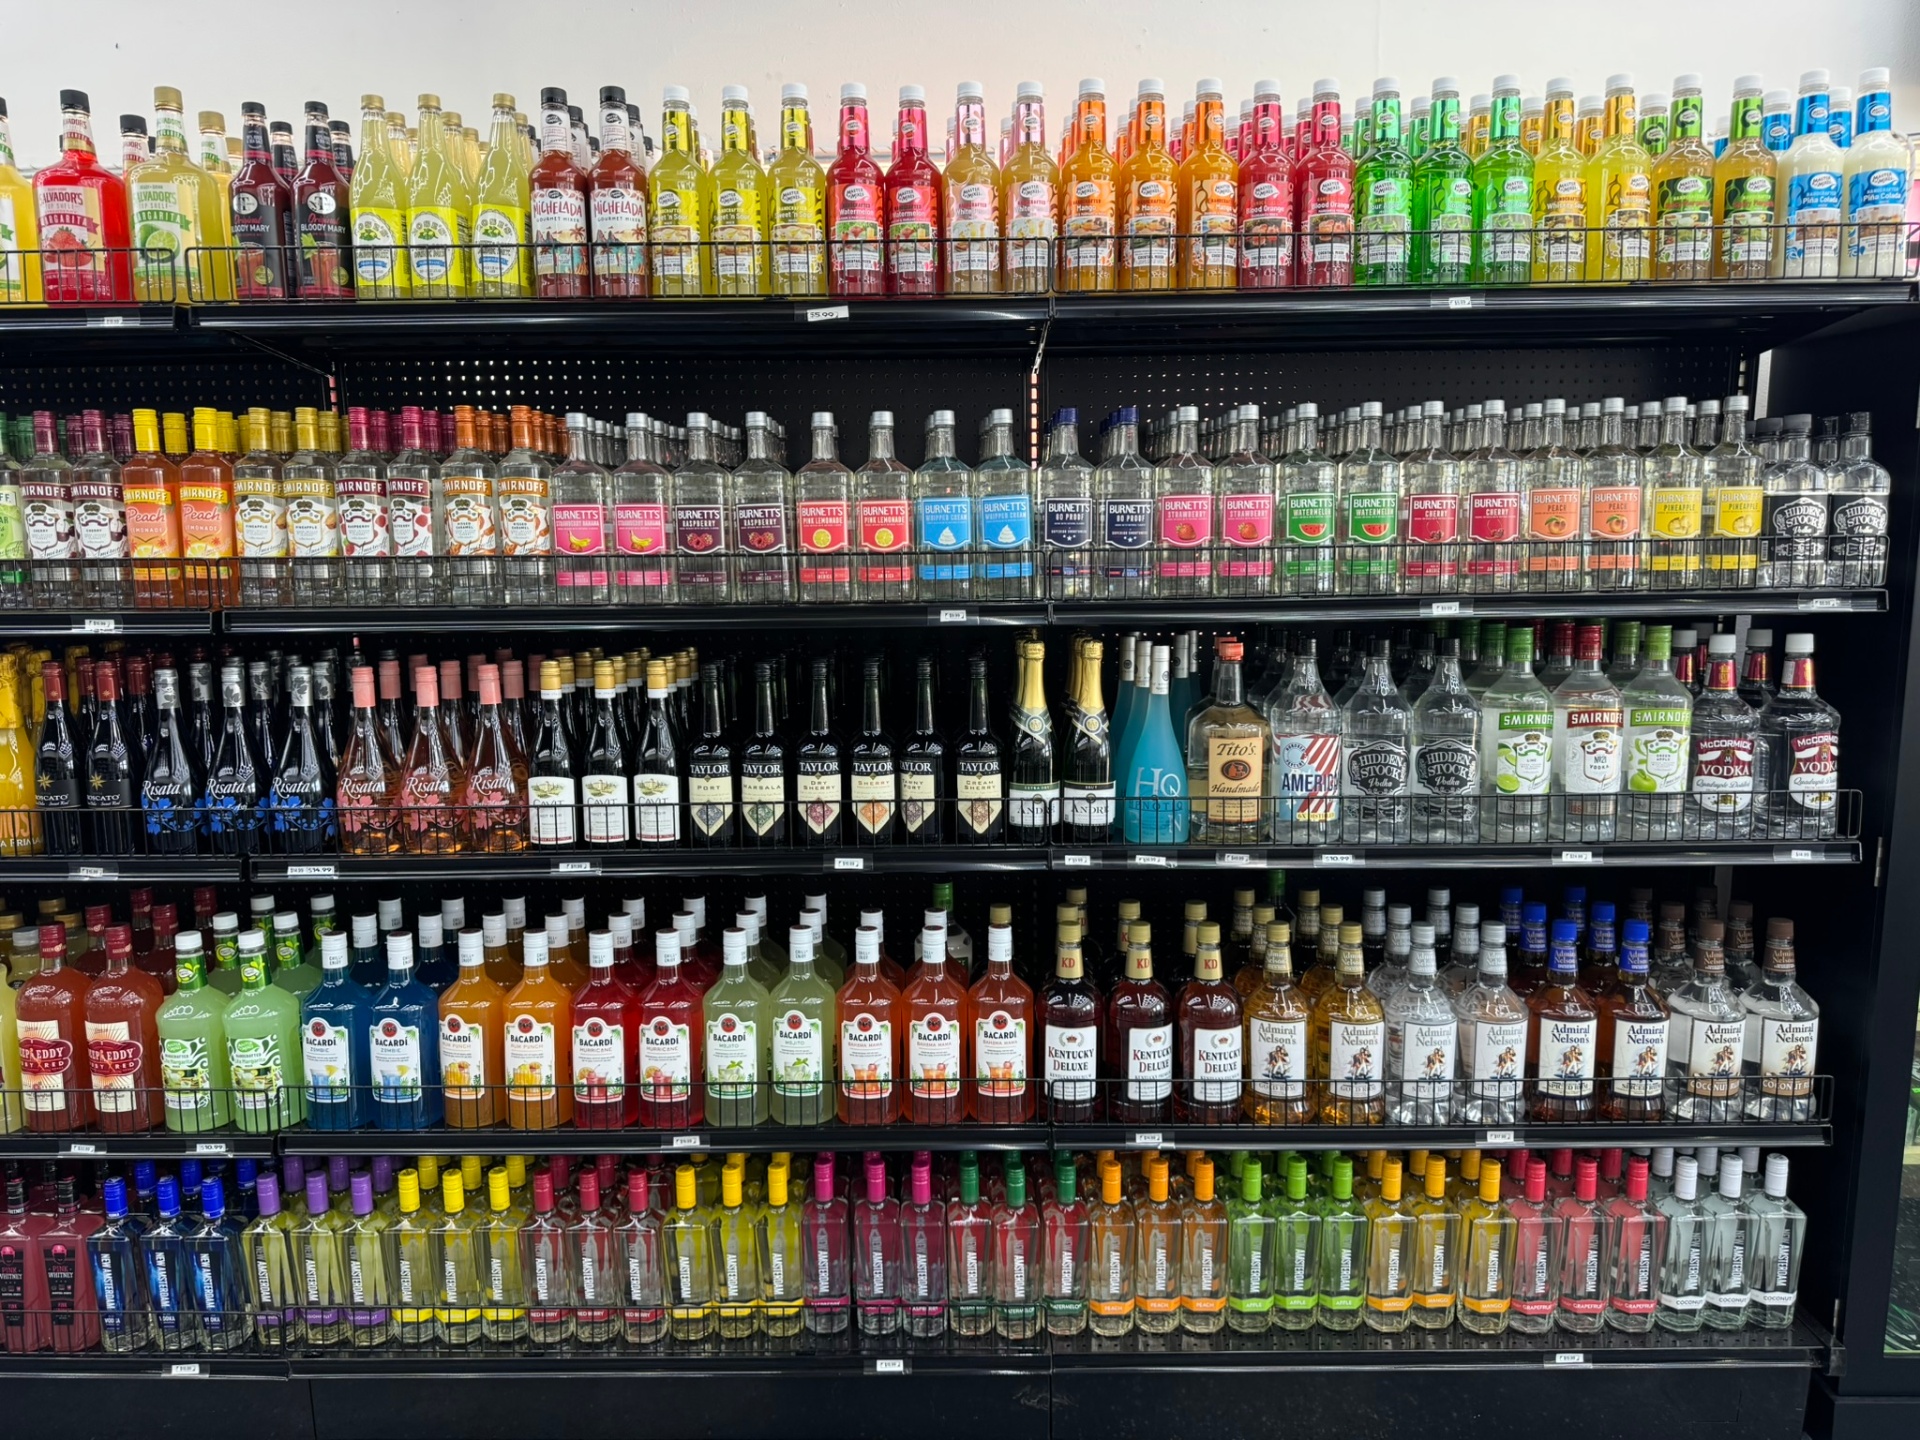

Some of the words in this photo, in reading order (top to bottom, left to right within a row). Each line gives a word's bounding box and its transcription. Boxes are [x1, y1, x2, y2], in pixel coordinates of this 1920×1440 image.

[136, 190, 177, 204] ALVADOR'S
[136, 209, 181, 223] ARGARITA
[300, 224, 326, 232] BLOODY
[327, 224, 346, 234] MARY
[1165, 501, 1208, 510] BURNETT'S
[1227, 500, 1269, 510] BURNETT'S
[1290, 498, 1333, 509] BURNETT'S
[1353, 498, 1396, 509] BURNETT'S
[1414, 499, 1456, 510] BURNETT'S
[1473, 498, 1517, 509] BURNETT'S
[127, 505, 166, 523] Peach
[183, 504, 221, 522] Peach
[1109, 504, 1150, 515] BURNETT'S
[1424, 510, 1448, 518] CHERRY
[1486, 509, 1509, 517] CHERRY
[1784, 508, 1821, 518] HIDDEN
[1845, 508, 1882, 518] HIDDEN
[1786, 516, 1821, 527] STOCK
[1847, 516, 1881, 527] STOCK
[1571, 712, 1623, 724] SMIRNOFF
[1635, 710, 1691, 723] SMIRNOFF
[1700, 739, 1752, 750] McCORMICK
[1358, 752, 1404, 766] HIDDEN
[1426, 752, 1471, 766] HIDDEN
[690, 764, 729, 774] TAYLOR
[742, 764, 782, 774] TAYLOR
[799, 762, 839, 772] TAYLOR
[853, 762, 893, 772] TAYLOR
[899, 762, 932, 772] AYLOR
[960, 762, 999, 771] TAYLOR
[1360, 765, 1402, 779] STOCK
[1428, 764, 1469, 778] STOCK
[1701, 763, 1750, 777] VODKA
[1368, 777, 1393, 788] Vodka
[1436, 776, 1461, 787] Vodka
[1210, 782, 1259, 795] Handmade
[86, 793, 120, 801] OSCATO
[1061, 957, 1076, 968] KD
[1204, 958, 1218, 969] KD
[1341, 1025, 1380, 1036] Admiral
[1415, 1025, 1452, 1036] Admiral
[1487, 1025, 1523, 1036] Admiral
[1551, 1023, 1590, 1034] Admiral
[1627, 1024, 1664, 1035] Admiral
[1705, 1023, 1741, 1035] Admiral
[1776, 1022, 1814, 1034] Admiral
[1415, 1036, 1453, 1047] Nelson's
[1487, 1035, 1524, 1047] Nelson's
[1551, 1033, 1590, 1044] Nelson's
[1627, 1034, 1664, 1045] Nelson's
[1704, 1034, 1741, 1045] Nelson's
[1776, 1032, 1814, 1044] Nelson's
[107, 1047, 135, 1060] EDDY
[1048, 1047, 1094, 1060] KENTUCKY
[1198, 1049, 1241, 1061] KENTUCKY
[115, 1061, 135, 1069] RED
[1053, 1060, 1089, 1071] DELUXE
[1138, 1059, 1169, 1072] DELUXE
[1204, 1061, 1237, 1073] DELUXE
[1202, 1249, 1212, 1291] AMSTERDAM
[1294, 1249, 1305, 1291] AMSTERDAM
[1389, 1248, 1400, 1291] AMSTERDAM
[1487, 1250, 1499, 1292] AMSTERDAM
[1586, 1250, 1598, 1292] AMSTERDAM
[1688, 1248, 1701, 1290] AMSTERDAM
[1776, 1244, 1790, 1287] AMSTERDAM
[47, 1271, 74, 1279] WHITNEY
[873, 1251, 884, 1294] AMSTERDAM
[967, 1251, 978, 1294] AMSTERDAM
[1062, 1251, 1073, 1294] AMSTERDAM
[102, 1268, 115, 1310] AMSTERDAM
[202, 1268, 214, 1310] AMSTERDAM
